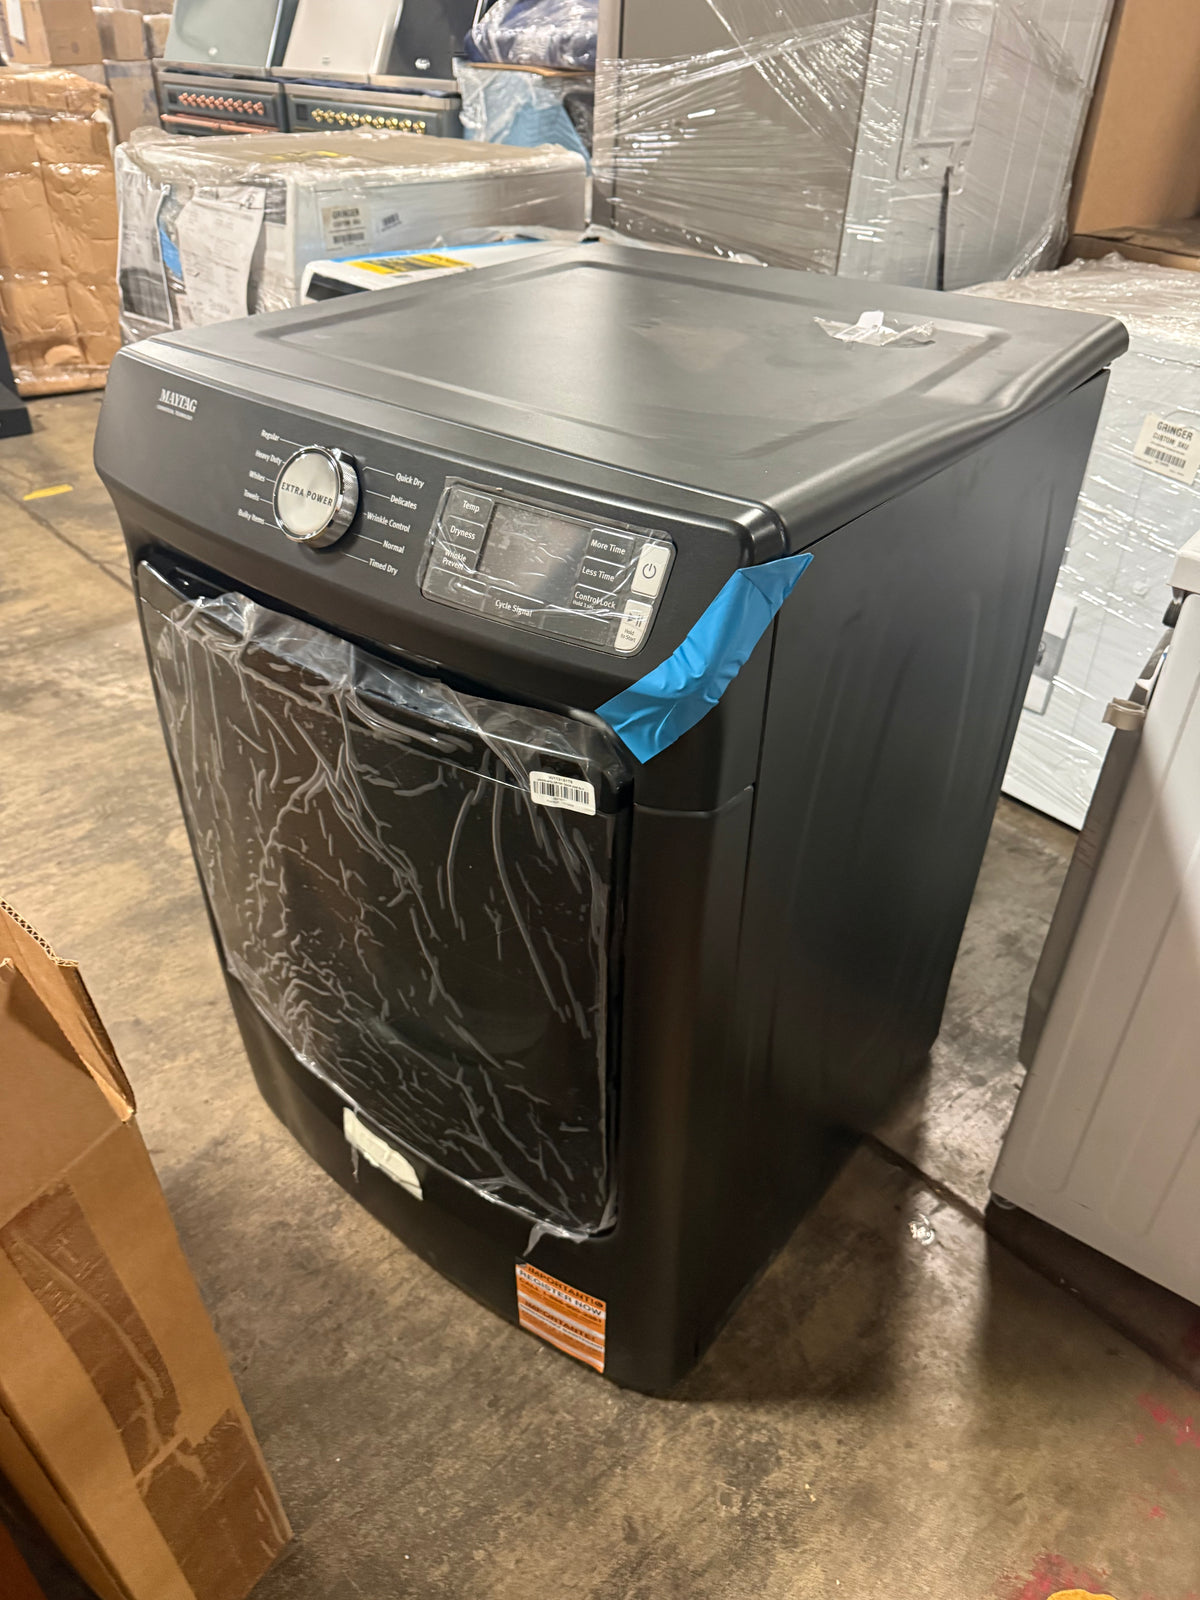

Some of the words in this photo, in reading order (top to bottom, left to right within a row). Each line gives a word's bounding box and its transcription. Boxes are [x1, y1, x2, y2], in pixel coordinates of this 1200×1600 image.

[158, 388, 198, 413] MAYTAG
[260, 429, 280, 441] Regular
[1157, 421, 1194, 441] GRINGER
[1152, 432, 1176, 445] CUSTOM
[1177, 441, 1190, 450] SKU
[254, 450, 270, 462] Heavy
[270, 454, 282, 466] Duty
[248, 470, 266, 482] Whites
[396, 472, 413, 484] Quick
[413, 478, 425, 489] Dry
[281, 482, 304, 497] EXTRA
[306, 490, 333, 506] POWER
[390, 495, 417, 510] Delicates
[463, 500, 480, 514] Temp
[367, 512, 388, 525] Wrinkle
[389, 519, 411, 533] Control
[450, 525, 476, 540] Dryness
[383, 540, 405, 554] Normal
[590, 539, 608, 551] More
[609, 545, 626, 555] Time
[445, 549, 466, 562] Wrinkle
[369, 558, 387, 571] Timed
[387, 565, 398, 576] Dry
[582, 566, 597, 577] Less
[598, 571, 615, 582] Time
[495, 600, 512, 611] Cycle
[512, 604, 533, 617] Signal
[575, 592, 599, 604] Control
[600, 598, 616, 609] Lock
[624, 628, 635, 636] Hold
[626, 635, 636, 643] Start
[519, 1270, 572, 1302] REGISTER
[574, 1300, 602, 1316] NOW
[528, 1266, 594, 1305] IMPORTANT!
